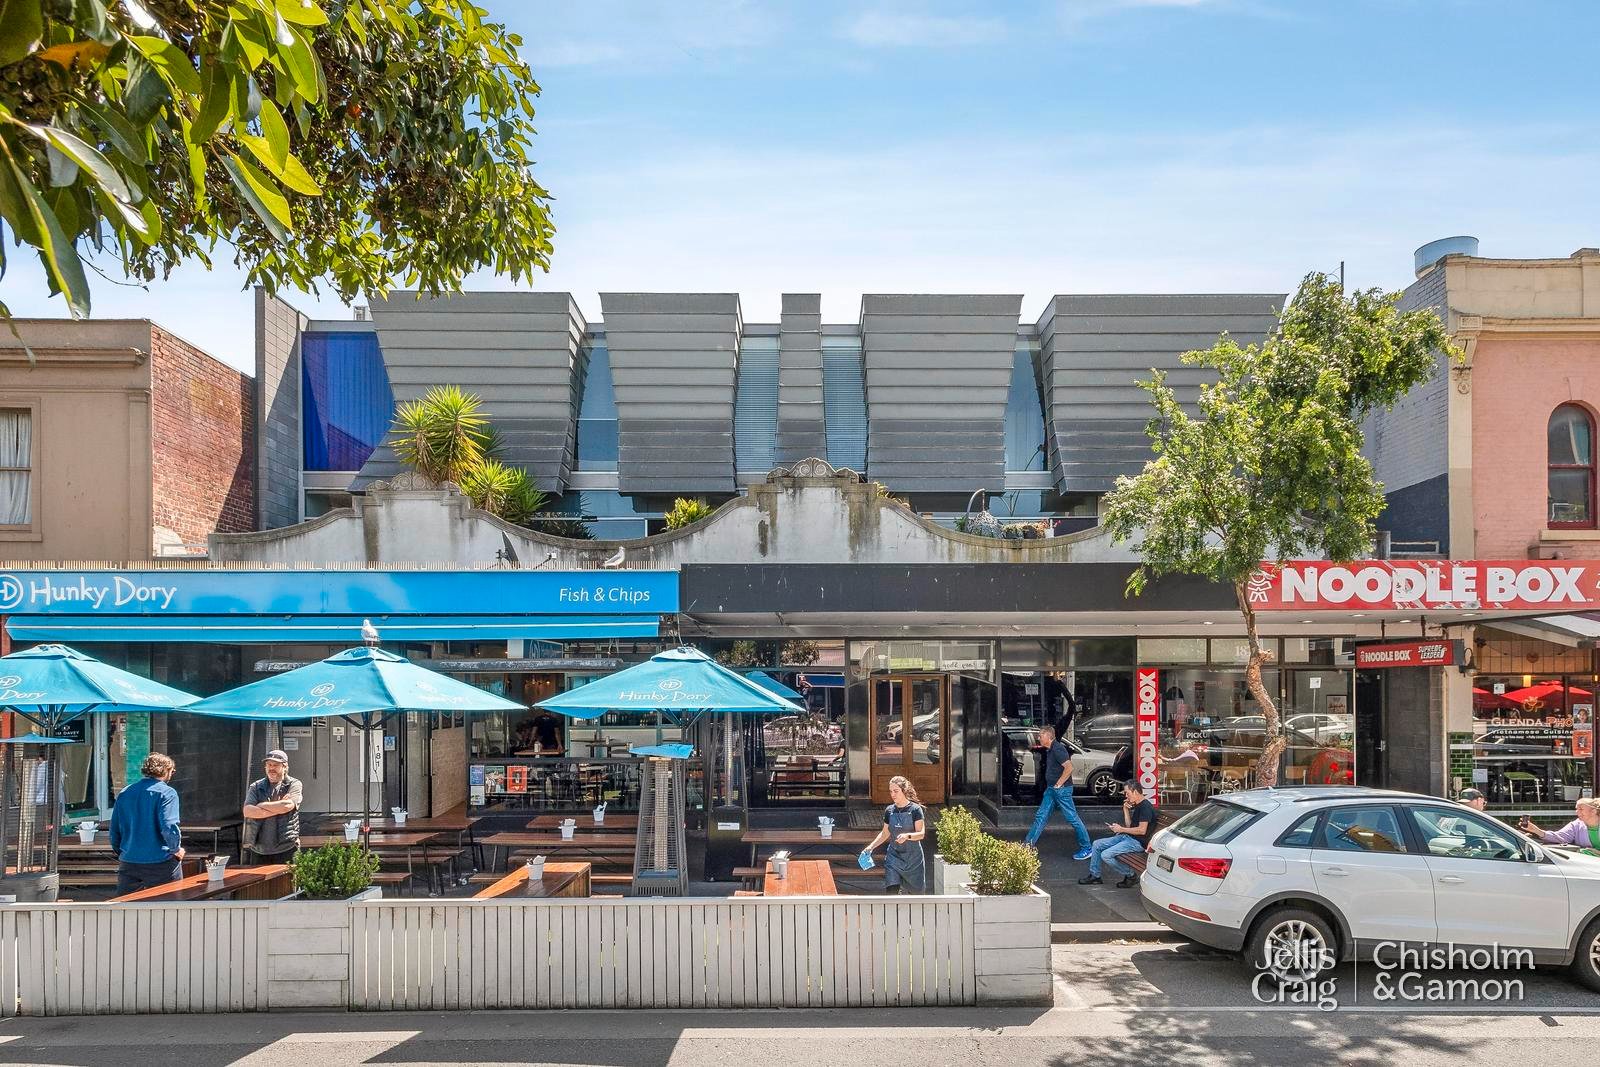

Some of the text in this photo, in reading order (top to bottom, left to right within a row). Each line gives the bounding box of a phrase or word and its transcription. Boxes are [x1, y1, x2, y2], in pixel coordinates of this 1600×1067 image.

[1281, 566, 1478, 603] NOODLE
[1486, 566, 1586, 603] BOX
[30, 576, 177, 610] Hunky Dory
[559, 587, 650, 606] Fish & Chips
[1365, 650, 1411, 662] NOODLE BOX
[0, 689, 48, 701] Dory
[618, 690, 712, 702] Hunky Dory
[263, 696, 351, 710] Hunky Dory
[1491, 717, 1543, 727] GLENDA
[1139, 671, 1157, 805] NOODLE BOX
[1186, 731, 1203, 739] PICK
[374, 744, 382, 767] 181
